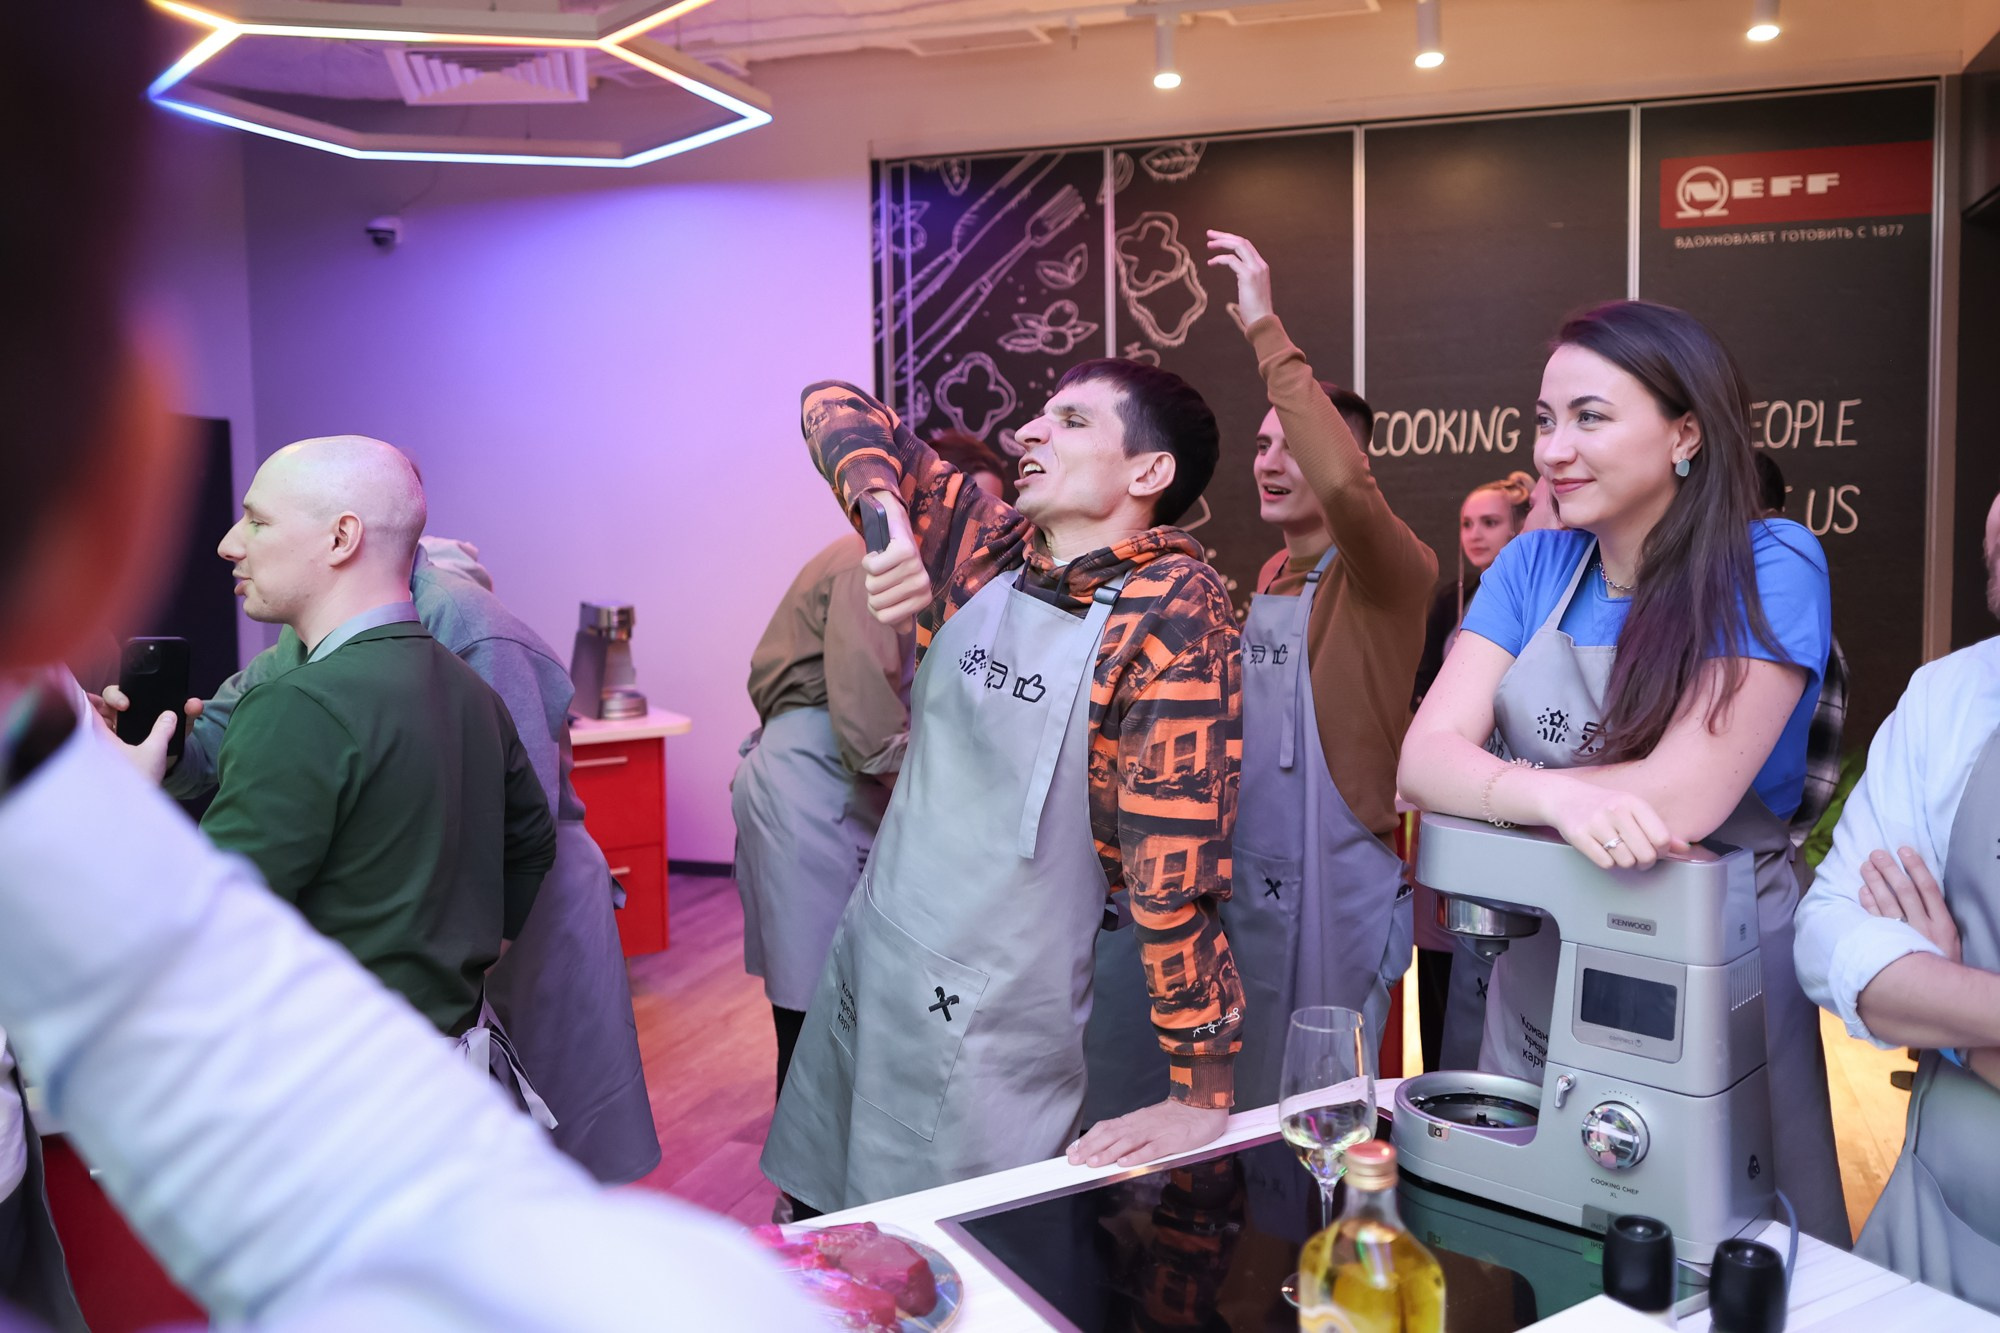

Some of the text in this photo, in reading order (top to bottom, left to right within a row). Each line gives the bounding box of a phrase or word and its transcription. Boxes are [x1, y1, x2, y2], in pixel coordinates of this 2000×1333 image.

[1677, 166, 1840, 212] NEFF
[1675, 230, 1776, 249] ВДОХНОВЛЯЕТ
[1781, 226, 1854, 242] ГОТОВИТЬ
[1872, 223, 1904, 238] 1877
[1368, 398, 1862, 457] COOKING EOPLE
[1806, 484, 1861, 536] US
[1611, 918, 1652, 931] KENWOOD
[1591, 1177, 1639, 1195] COOKING CHEF
